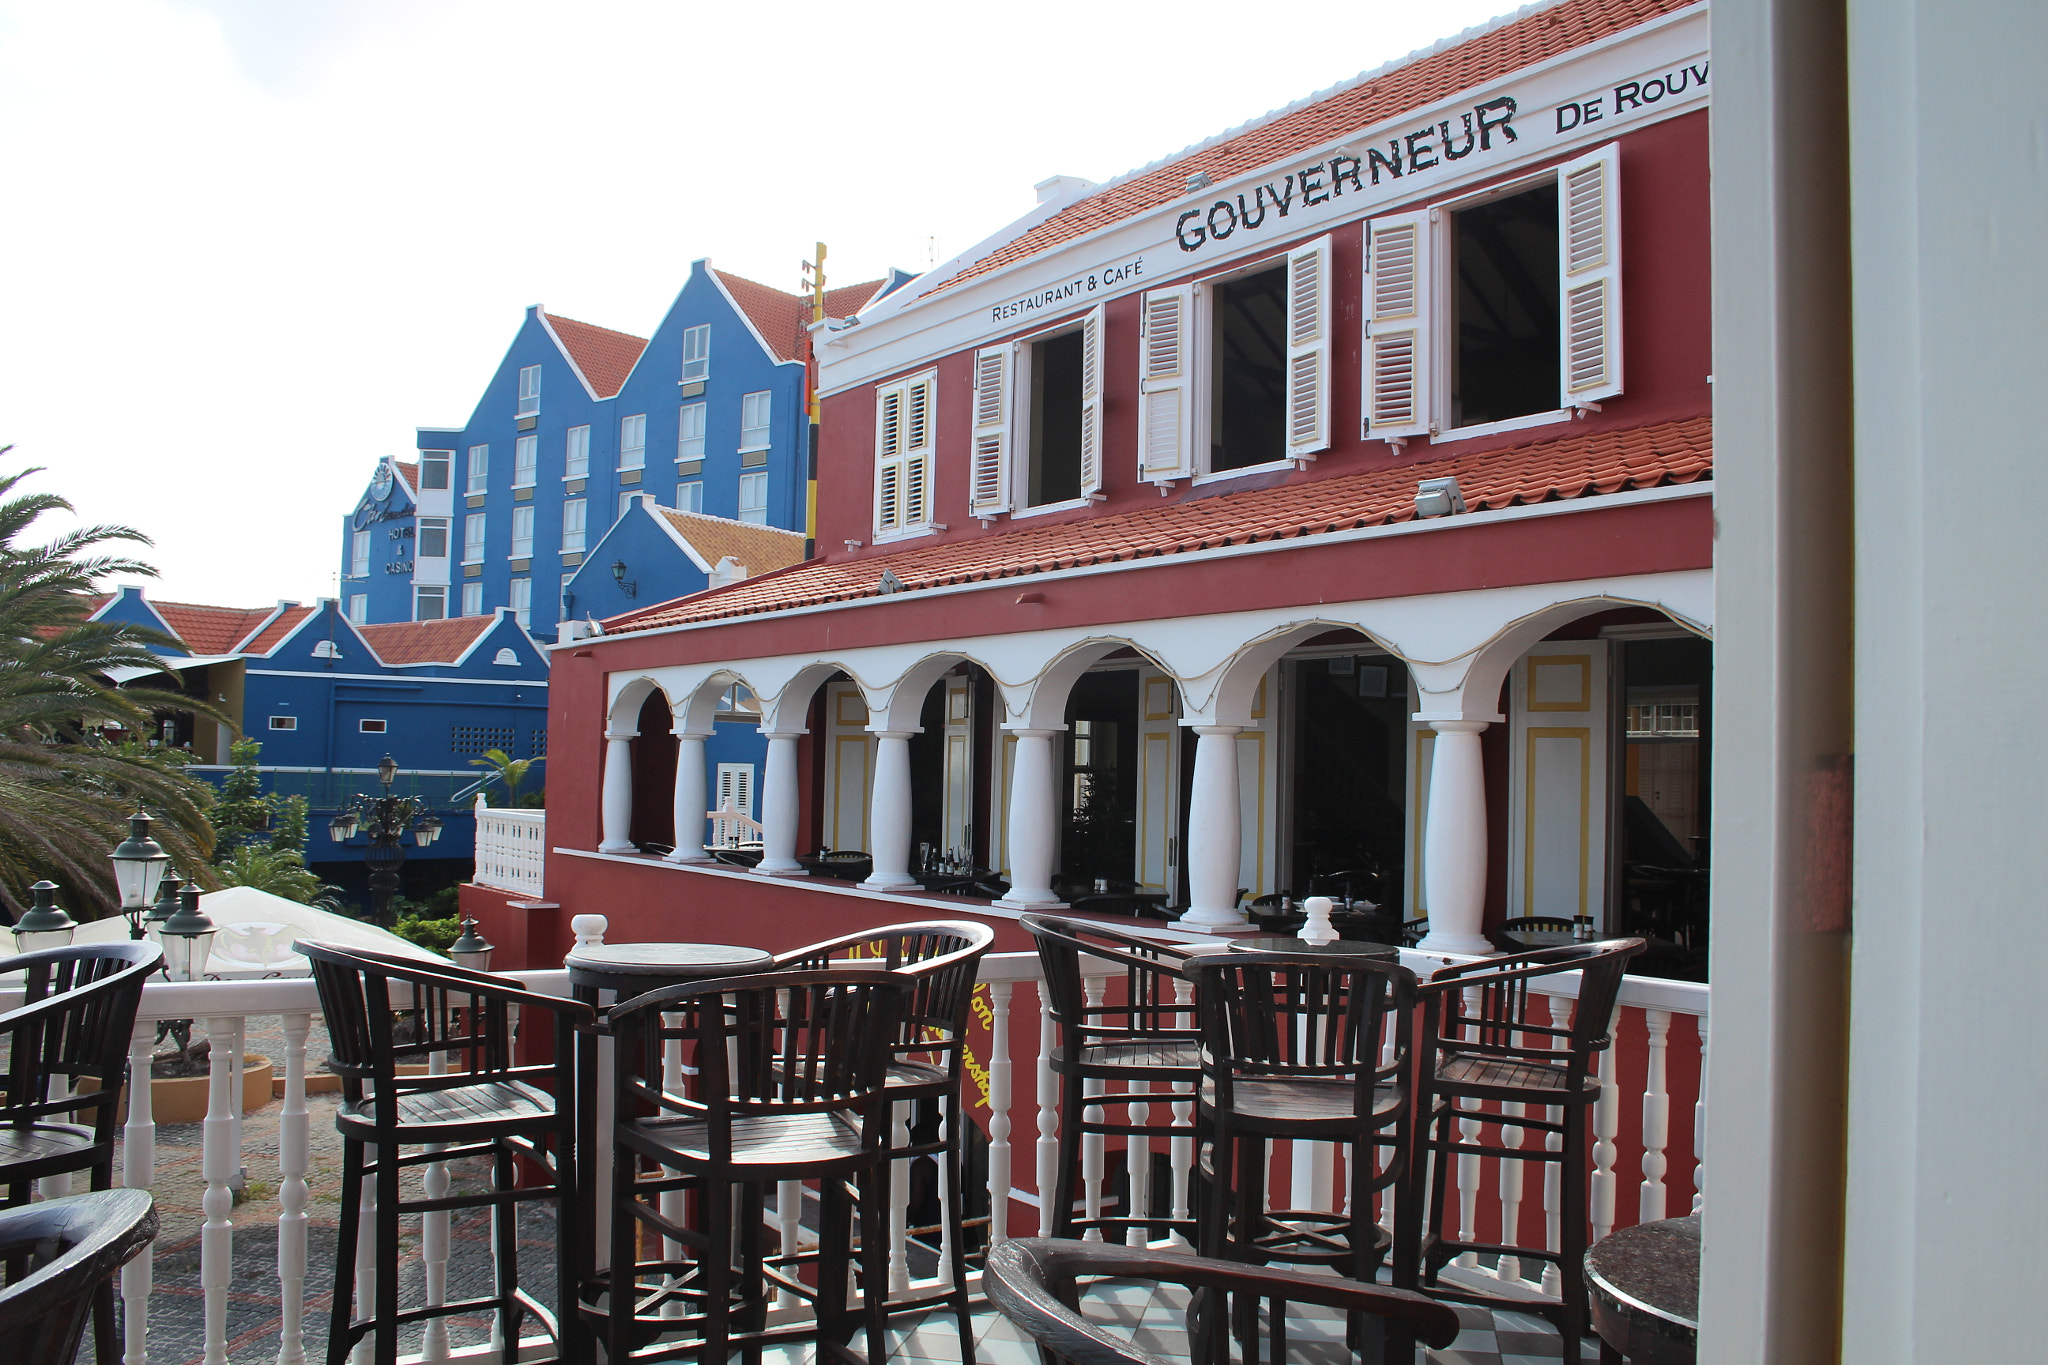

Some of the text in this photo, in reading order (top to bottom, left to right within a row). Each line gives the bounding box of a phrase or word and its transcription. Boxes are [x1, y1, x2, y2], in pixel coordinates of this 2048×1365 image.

[992, 280, 1083, 323] RESTAURANT
[1087, 275, 1098, 292] &
[1103, 256, 1143, 286] CAFÉ
[1176, 96, 1518, 252] GOUVERNEUR
[1555, 97, 1603, 134] DE
[389, 527, 415, 540] HOTEL
[385, 560, 414, 575] CASINO
